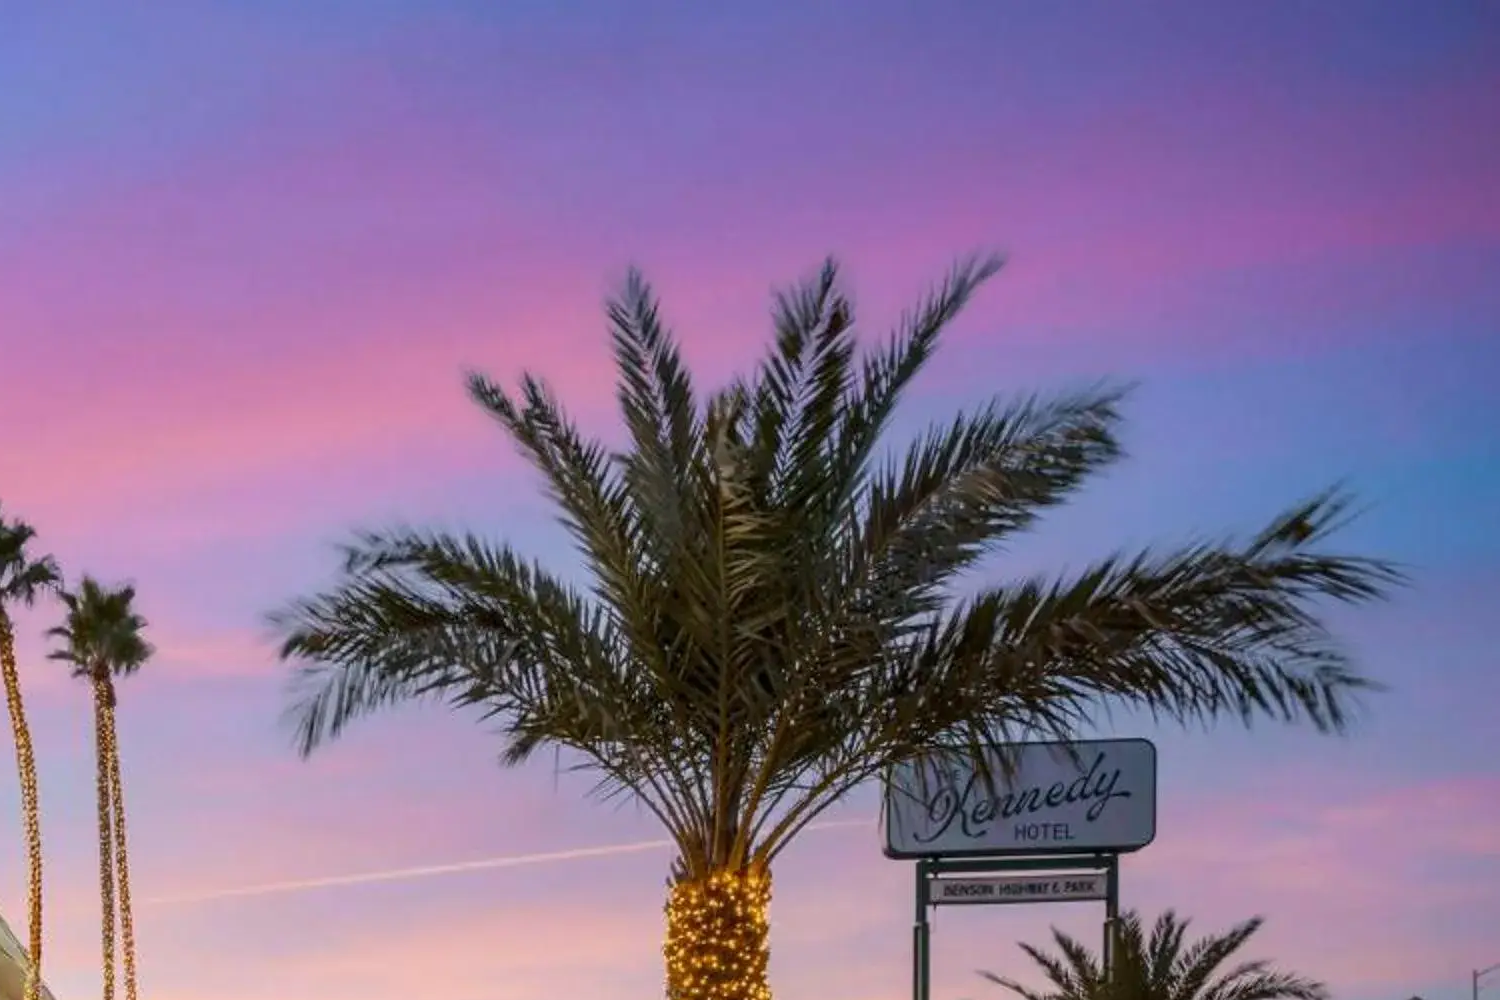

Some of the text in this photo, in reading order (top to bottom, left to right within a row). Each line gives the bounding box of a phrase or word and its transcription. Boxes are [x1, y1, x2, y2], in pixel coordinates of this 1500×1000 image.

[913, 752, 1132, 843] Kennedy
[1014, 823, 1075, 841] HOTEL
[943, 883, 994, 897] BENSON
[1064, 879, 1095, 893] PARK
